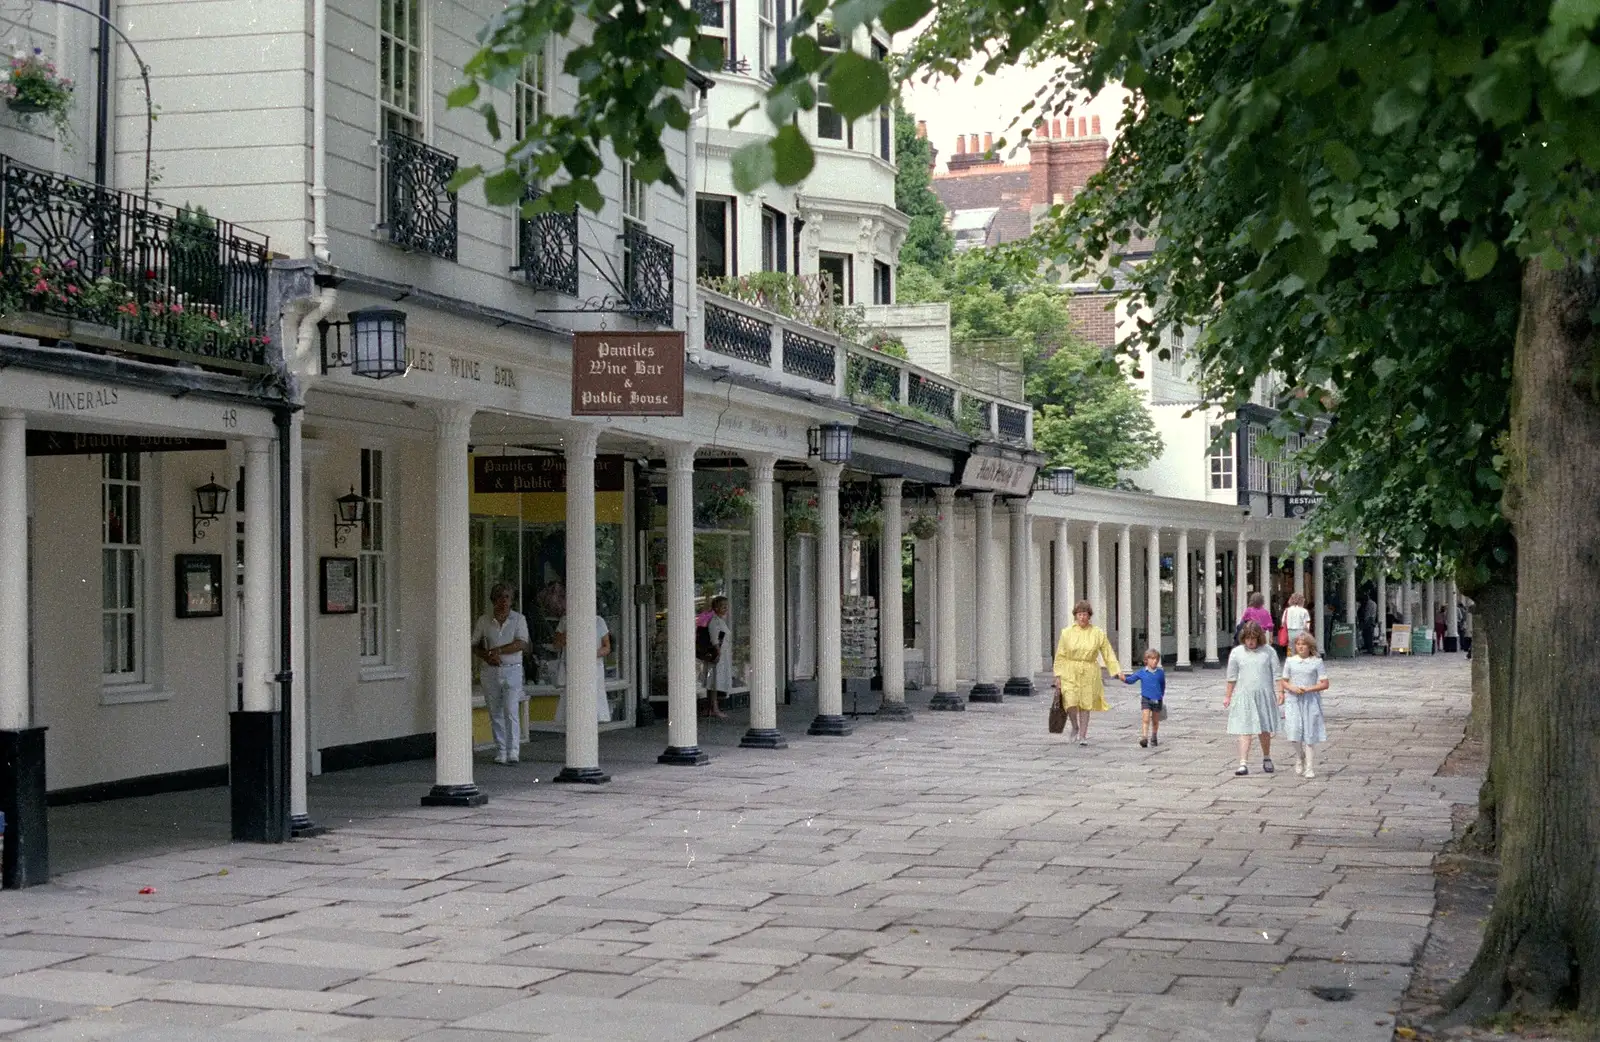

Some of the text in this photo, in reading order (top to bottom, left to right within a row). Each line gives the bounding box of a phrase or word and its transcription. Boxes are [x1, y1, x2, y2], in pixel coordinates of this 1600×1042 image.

[598, 341, 656, 358] Pantiles
[449, 355, 481, 381] WINE
[589, 359, 665, 376] Wine Bar
[623, 378, 633, 389] &
[48, 388, 119, 411] MINERALS
[581, 391, 669, 406] Public House
[221, 409, 238, 428] 48
[484, 459, 611, 474] Pantiles Win ar
[513, 475, 554, 492] Public
[1289, 497, 1322, 505] RESTAU
